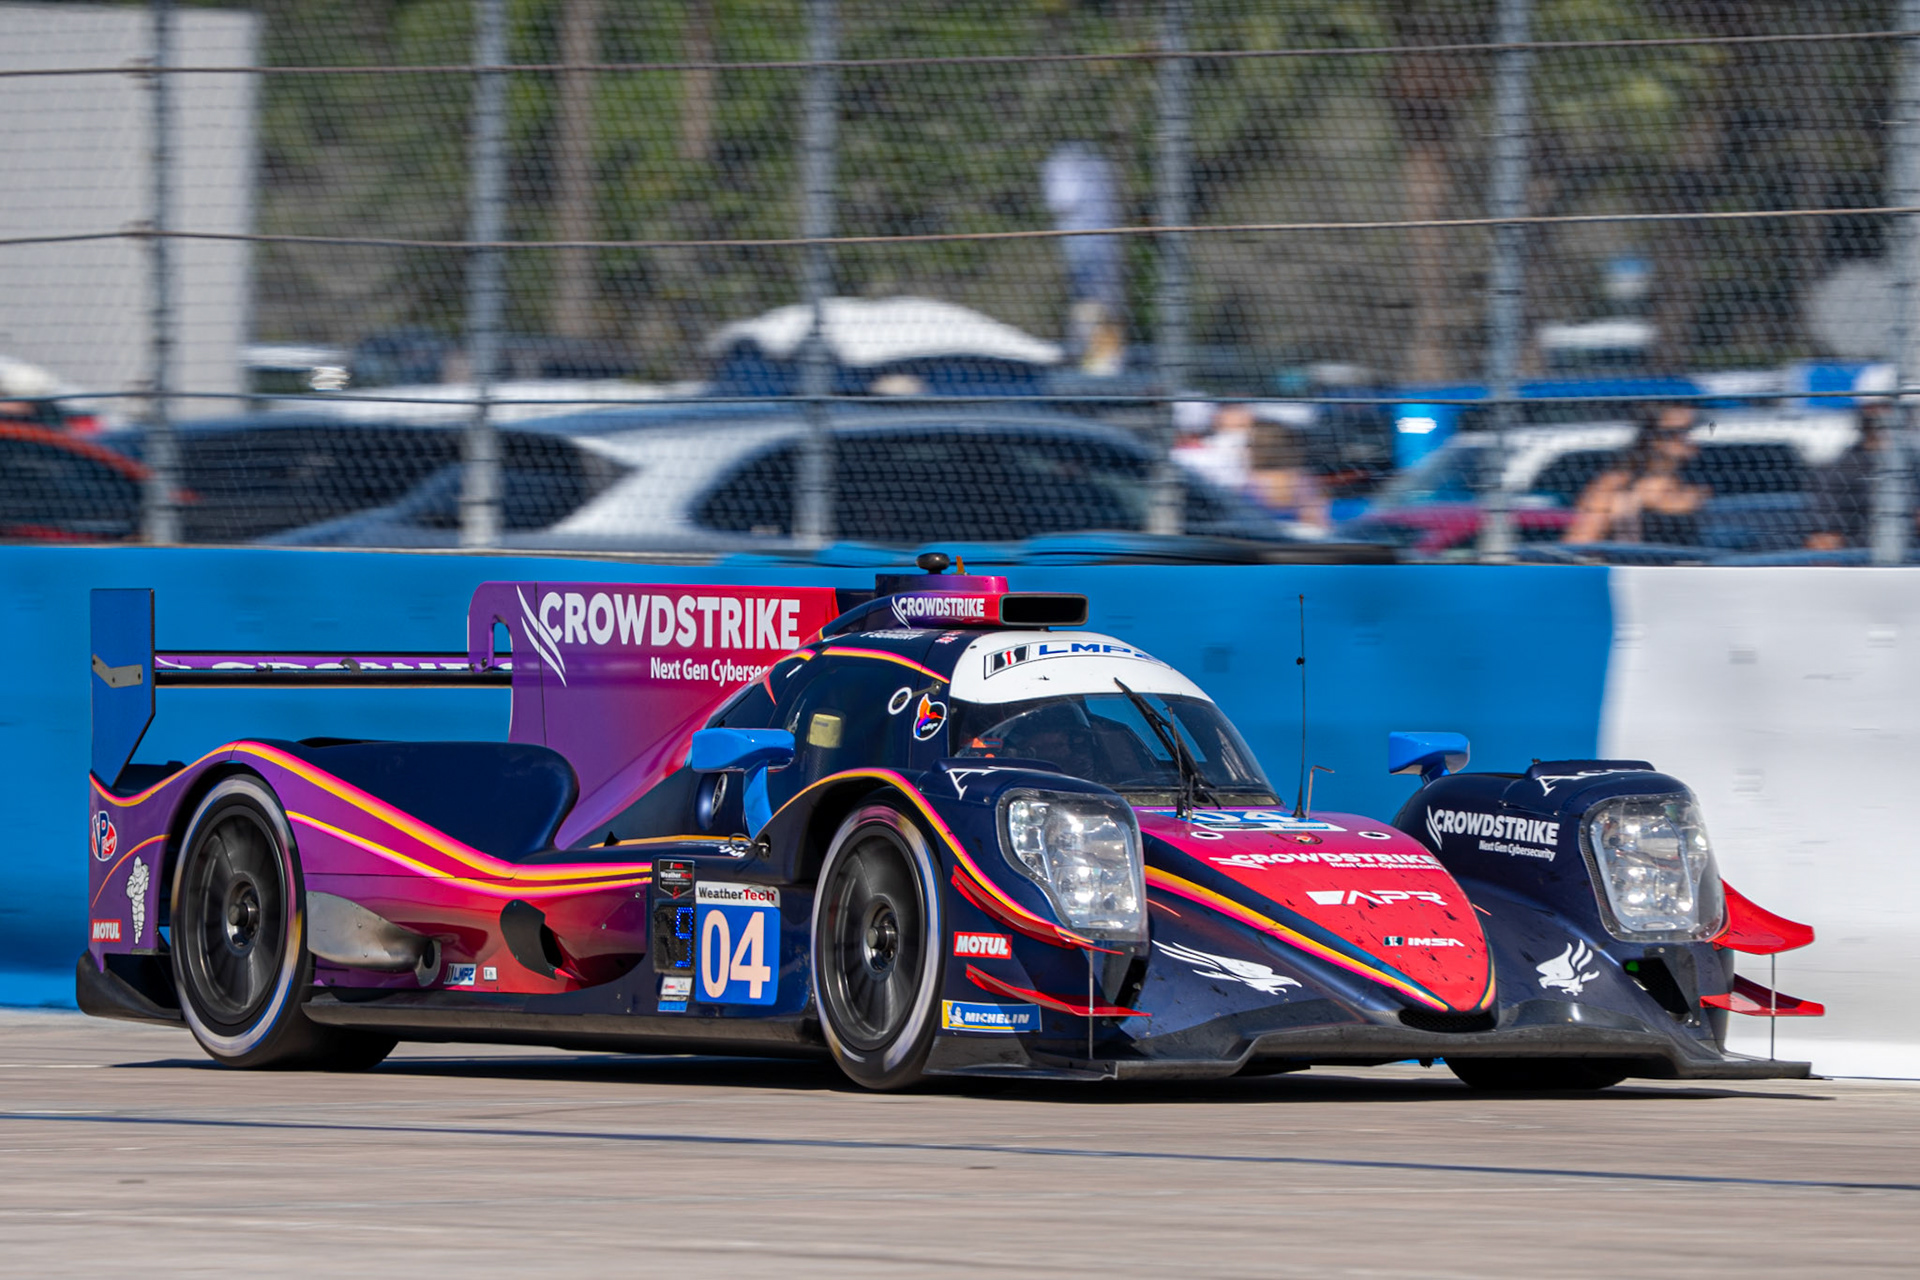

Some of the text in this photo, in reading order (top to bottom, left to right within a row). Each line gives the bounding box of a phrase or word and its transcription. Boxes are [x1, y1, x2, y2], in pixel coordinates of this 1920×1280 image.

[898, 596, 985, 617] CROWDSTRIKE
[539, 591, 800, 650] CROWDSTRIKE
[651, 657, 681, 681] Next
[683, 659, 709, 681] Gen
[1433, 809, 1560, 845] CROWDSTRIKE
[1230, 852, 1441, 866] CROWDSTRIKE
[1479, 840, 1556, 862] Next Gen Cybersecurity
[698, 886, 775, 901] WeatherTech
[1347, 890, 1448, 906] APR
[93, 922, 121, 940] MOTUL
[955, 935, 1009, 955] MOTUL
[1408, 937, 1465, 947] IMSA
[701, 909, 771, 999] 04
[965, 1011, 1030, 1024] MICHELIN
